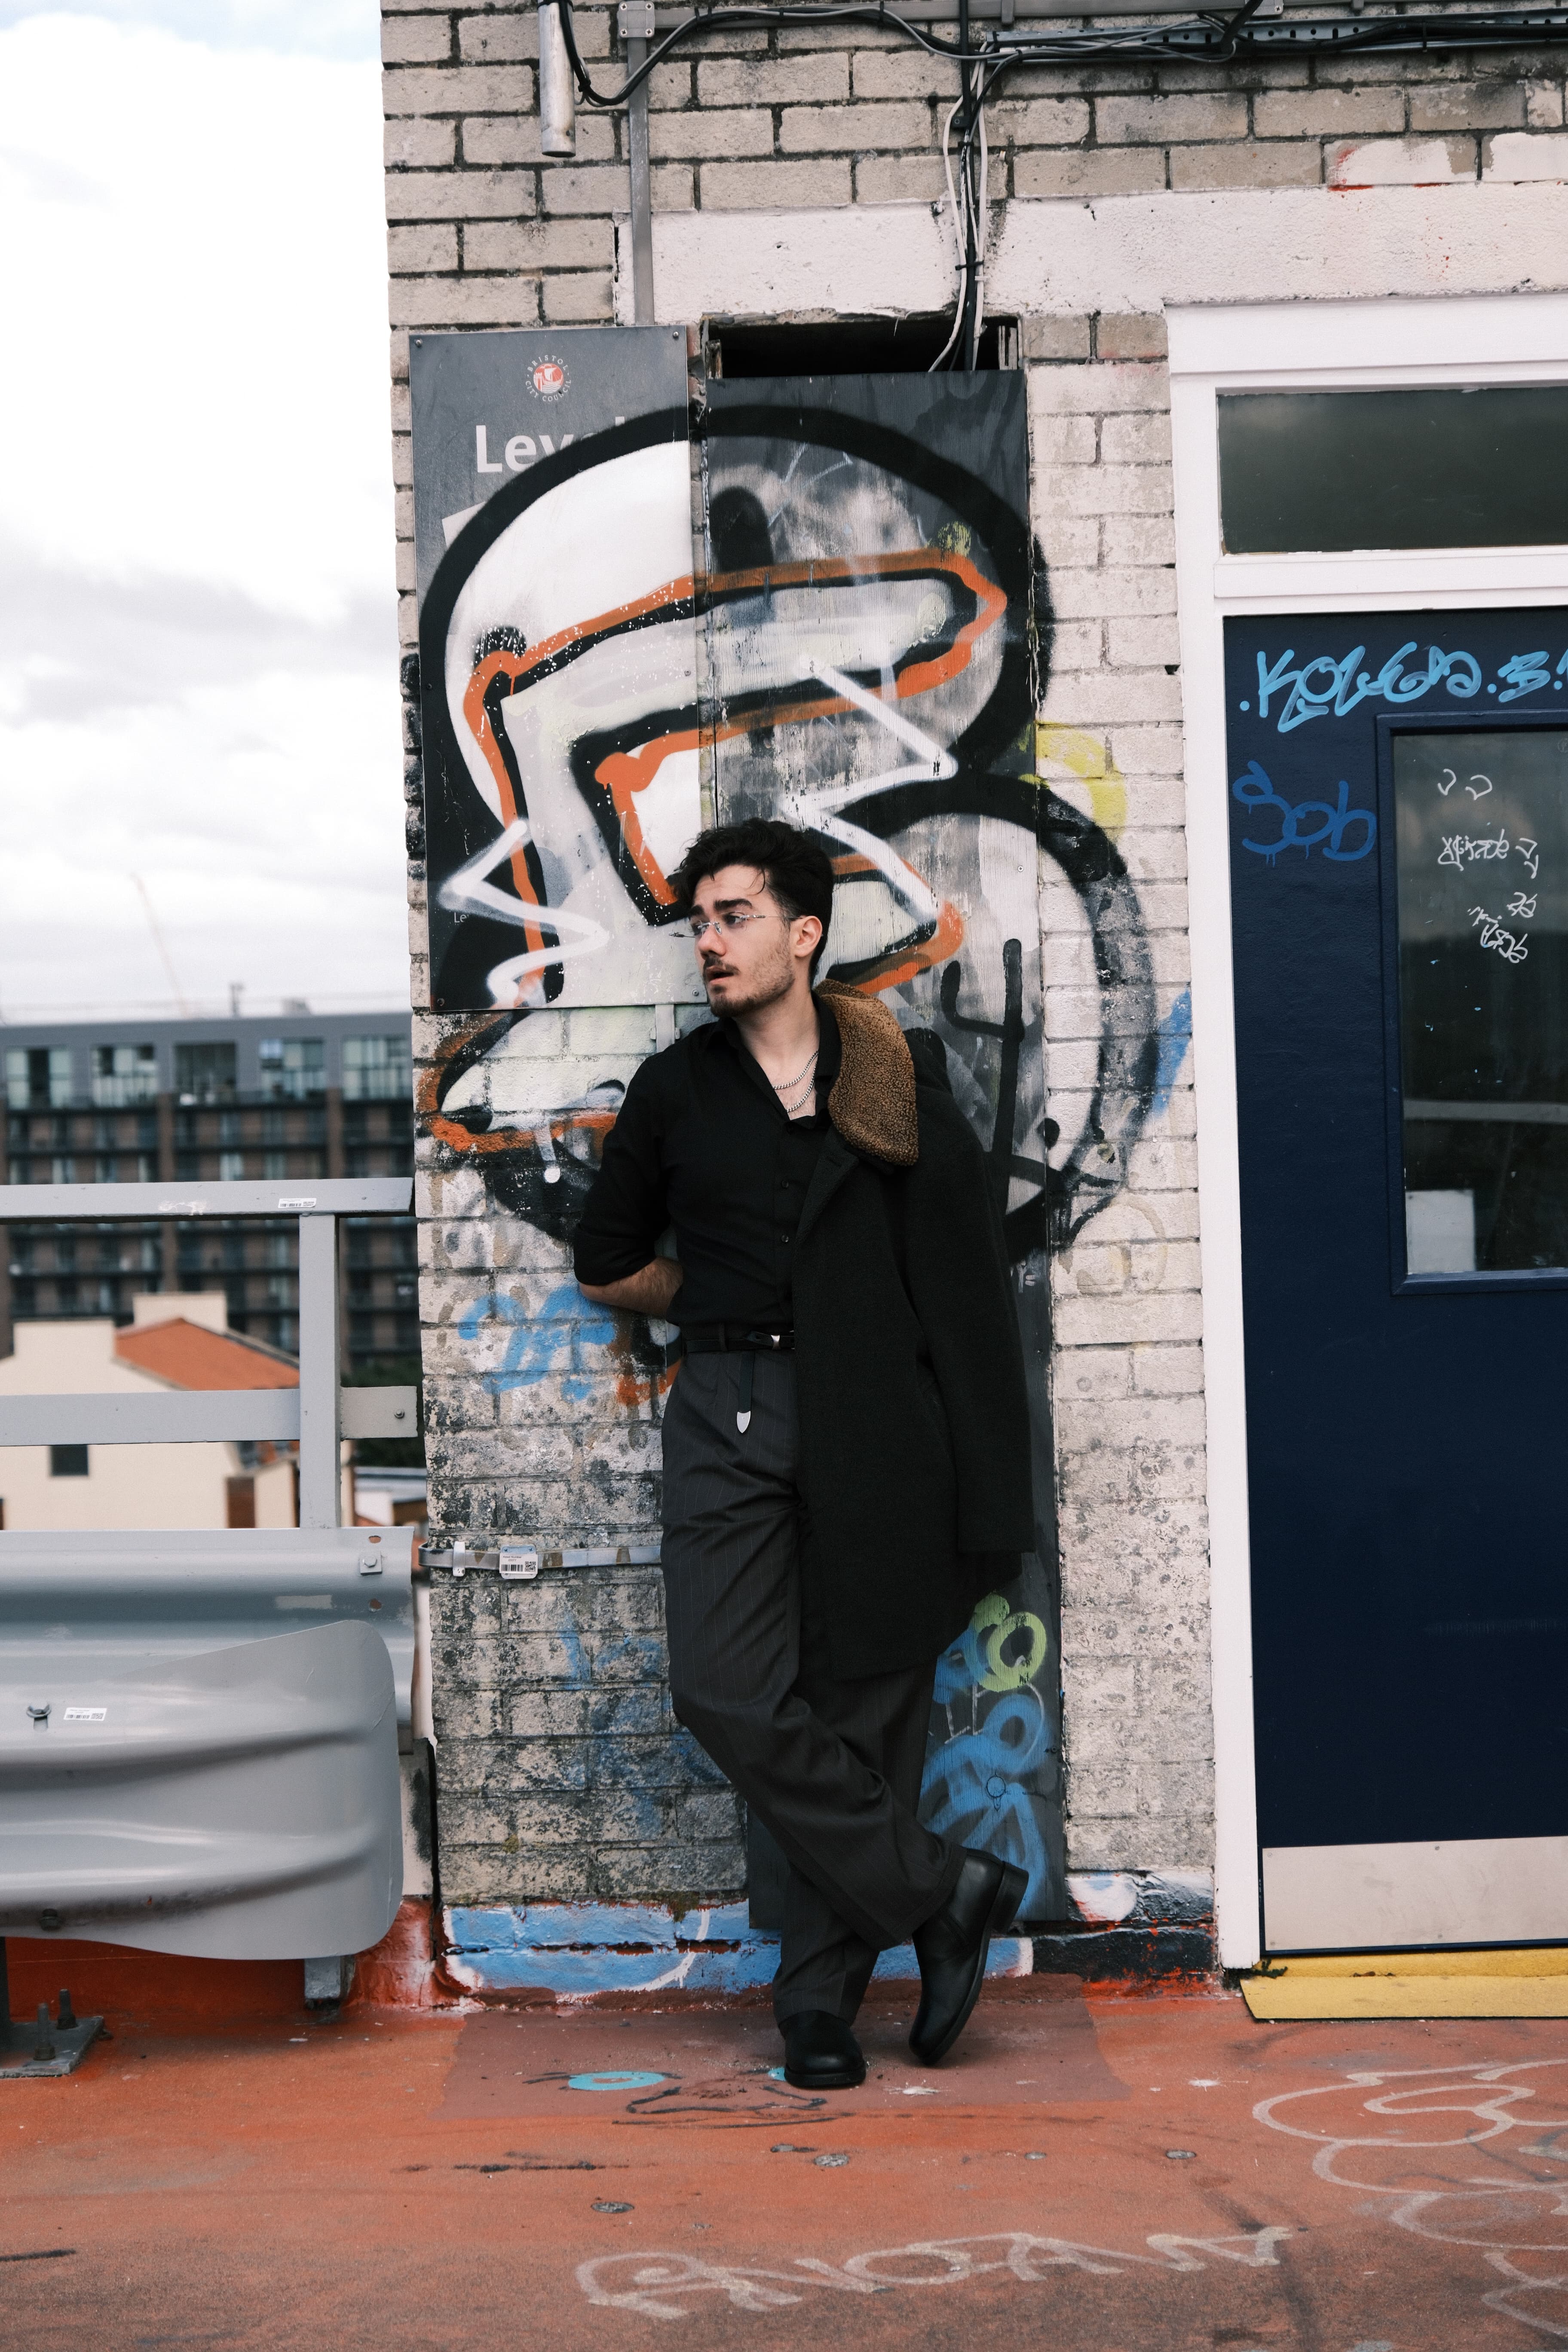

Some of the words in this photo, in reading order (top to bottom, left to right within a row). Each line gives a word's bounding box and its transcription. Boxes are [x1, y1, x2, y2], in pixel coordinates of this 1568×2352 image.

[527, 355, 568, 372] BRISTOL
[525, 381, 539, 398] CITY
[542, 380, 571, 401] COUNCIL
